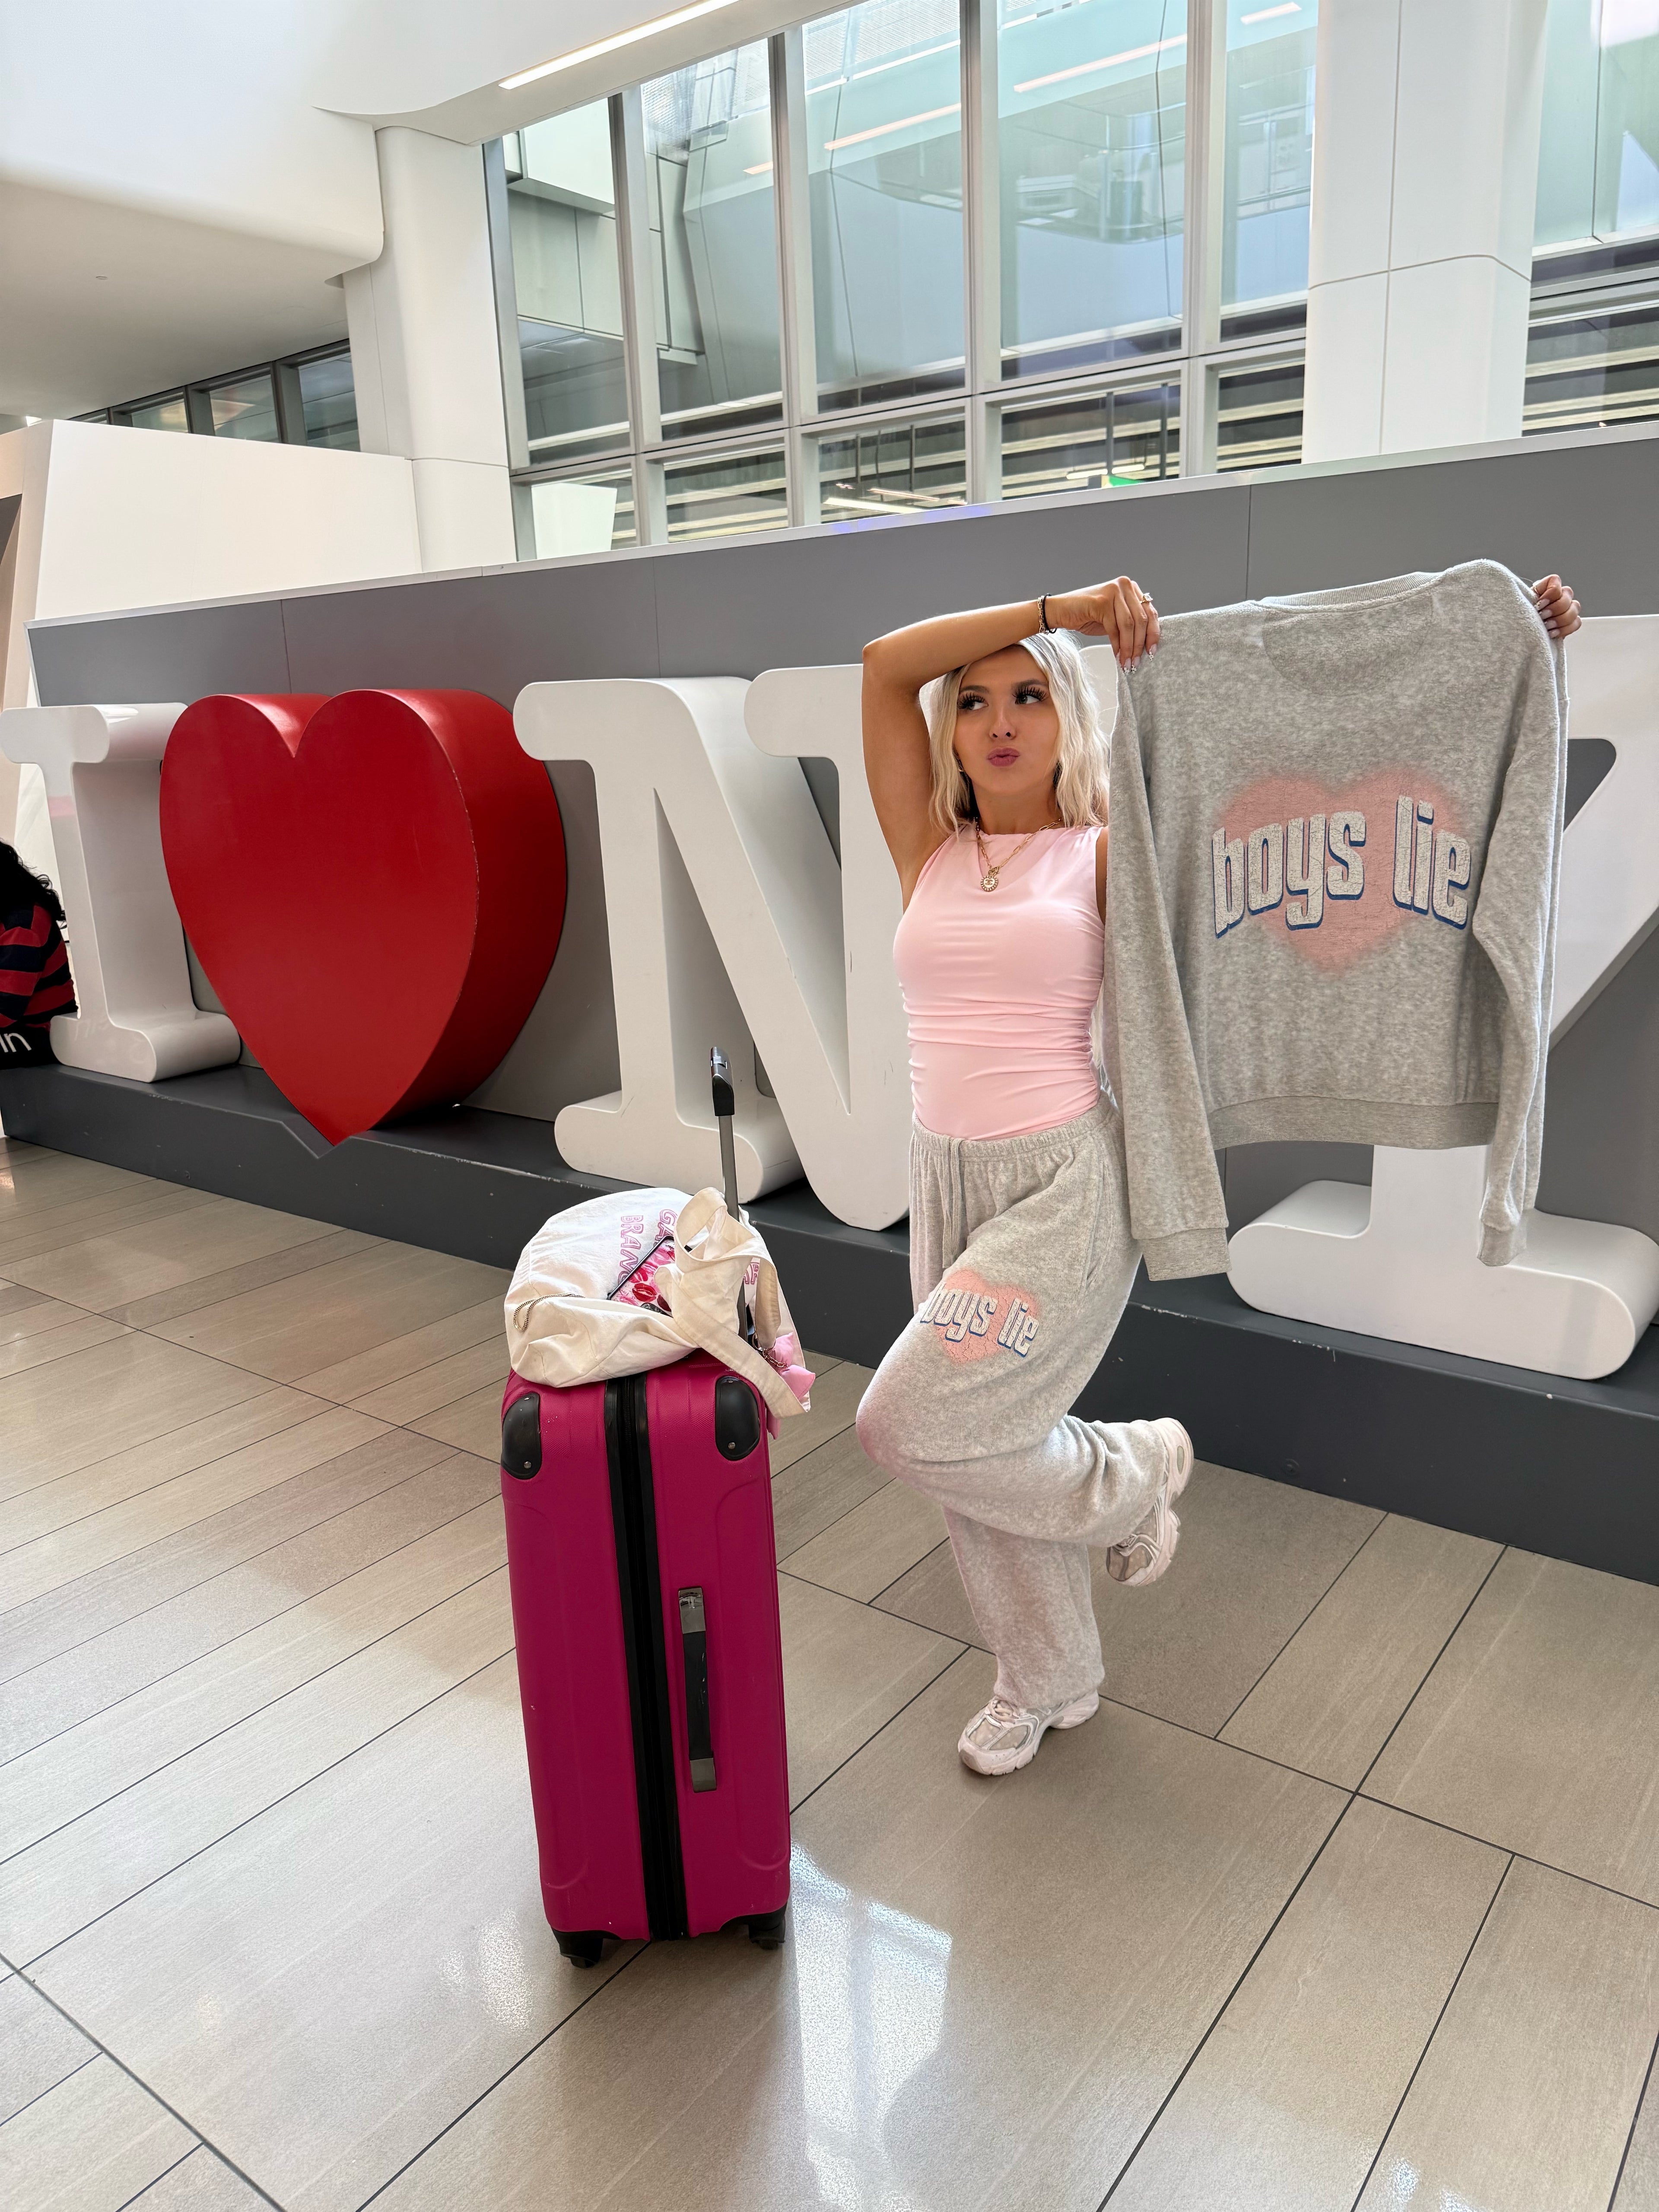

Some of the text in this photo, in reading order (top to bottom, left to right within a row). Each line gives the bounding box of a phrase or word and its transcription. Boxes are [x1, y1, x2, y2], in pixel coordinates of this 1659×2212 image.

[1212, 795, 1470, 938] boys lie
[997, 1297, 1039, 1357] lie
